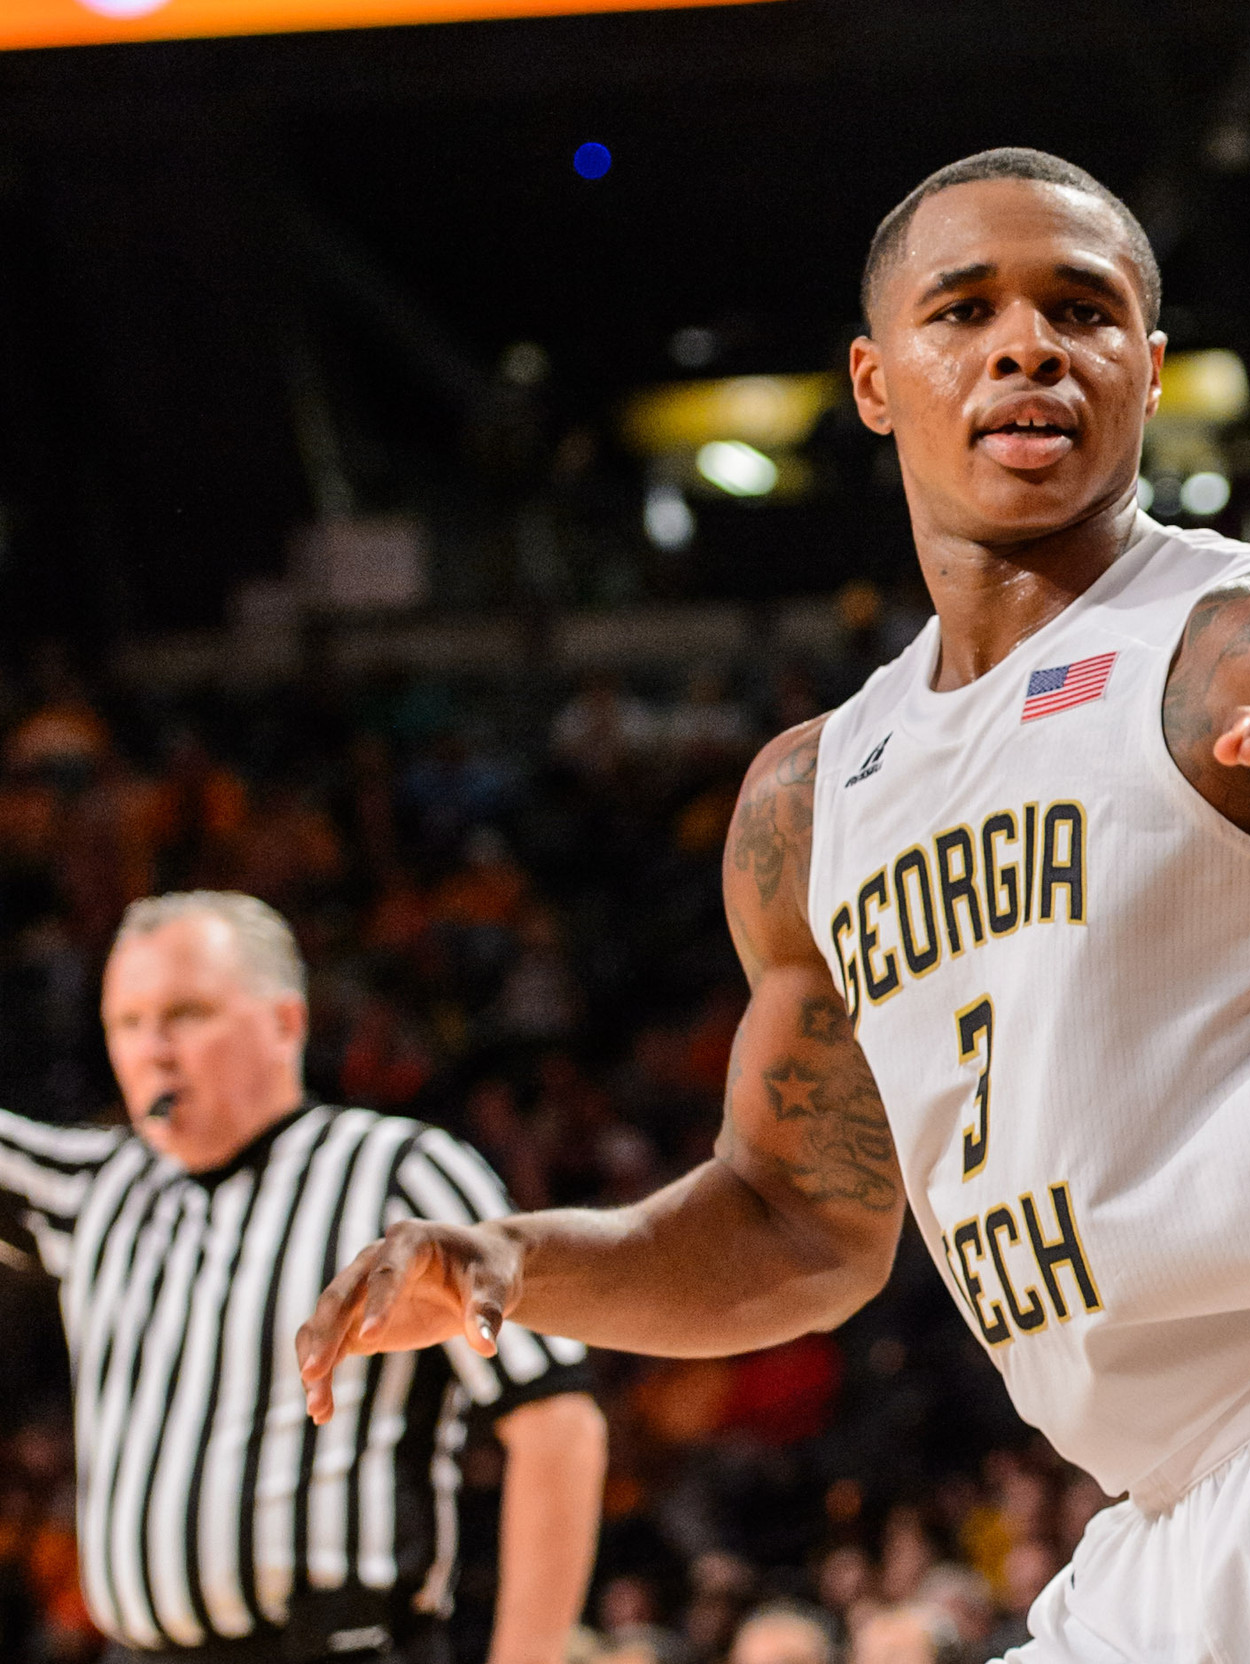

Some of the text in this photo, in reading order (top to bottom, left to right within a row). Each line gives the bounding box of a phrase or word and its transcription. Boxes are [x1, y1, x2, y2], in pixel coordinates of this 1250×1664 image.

[831, 799, 1087, 1041] GEORGIA
[954, 992, 996, 1183] 3
[942, 1181, 1105, 1349] ECH
